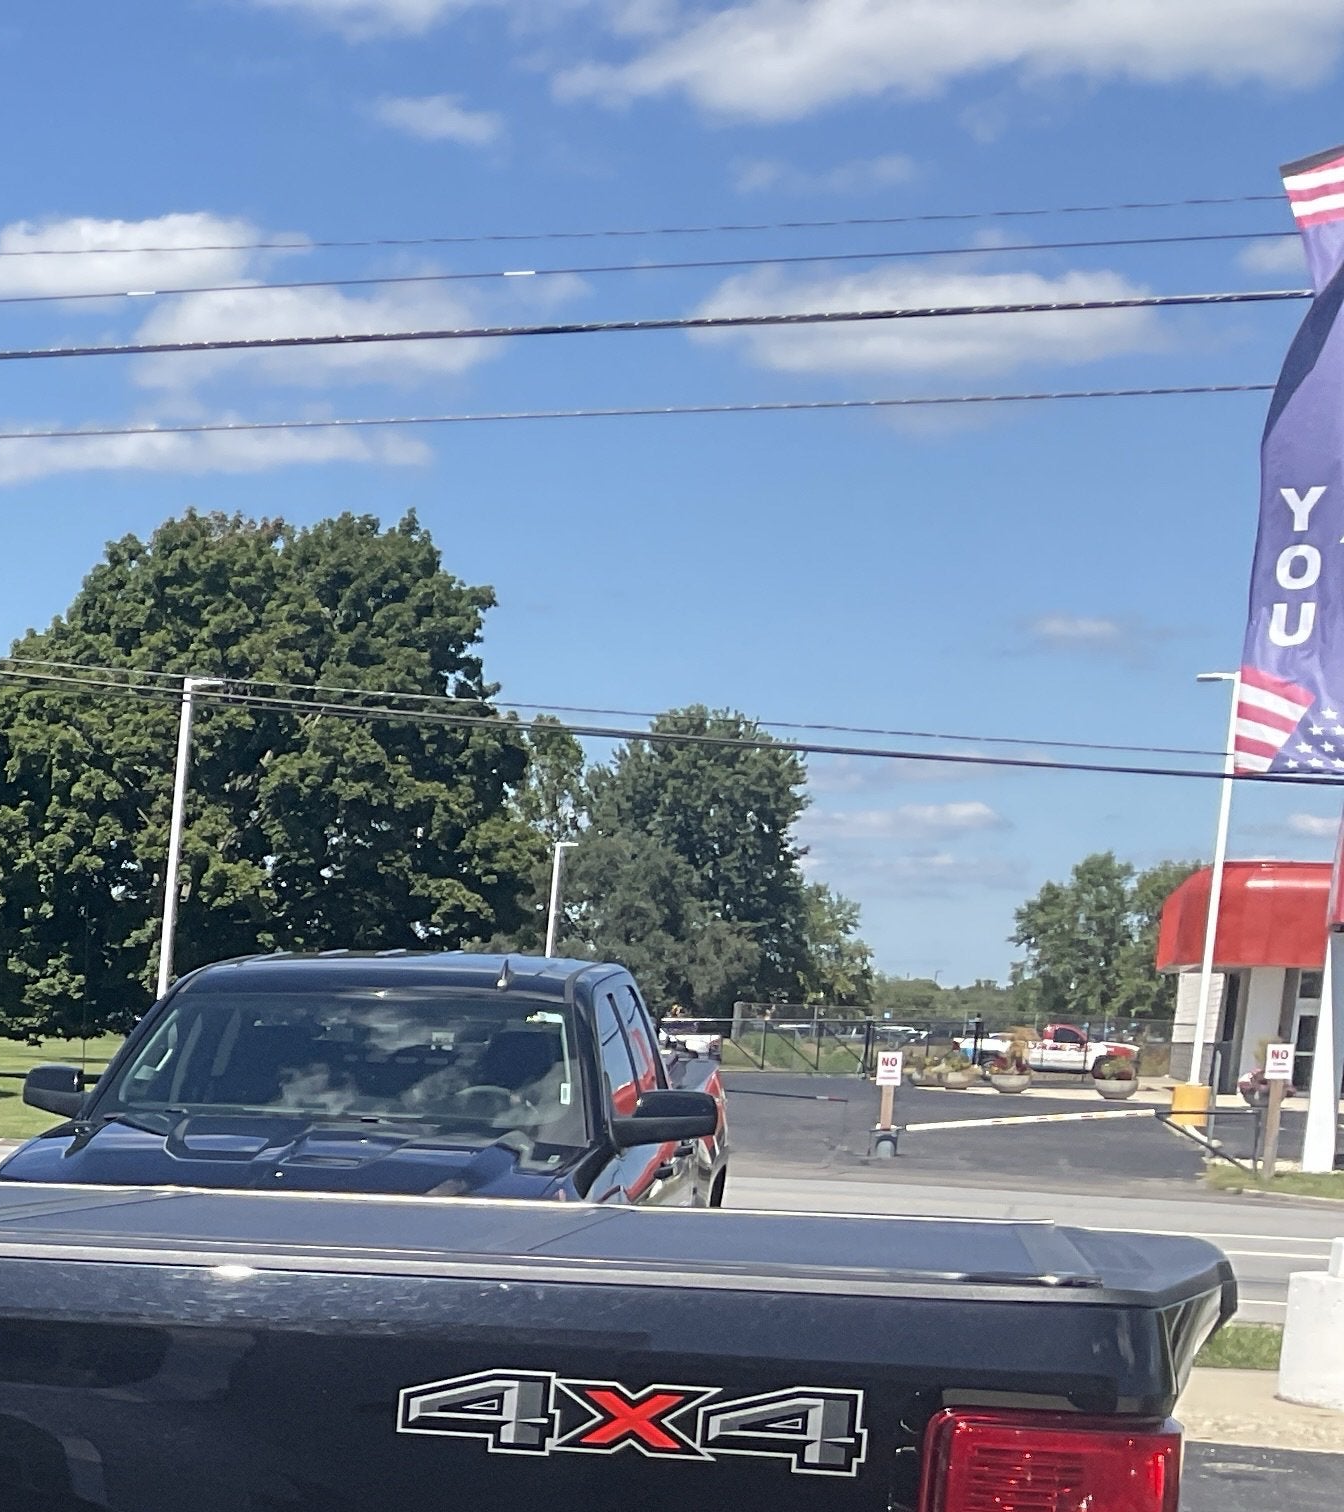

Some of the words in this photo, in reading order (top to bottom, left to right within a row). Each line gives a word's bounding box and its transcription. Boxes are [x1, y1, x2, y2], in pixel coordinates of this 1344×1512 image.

[1268, 486, 1328, 647] YOU
[1271, 1049, 1289, 1060] NO
[881, 1057, 898, 1067] NO
